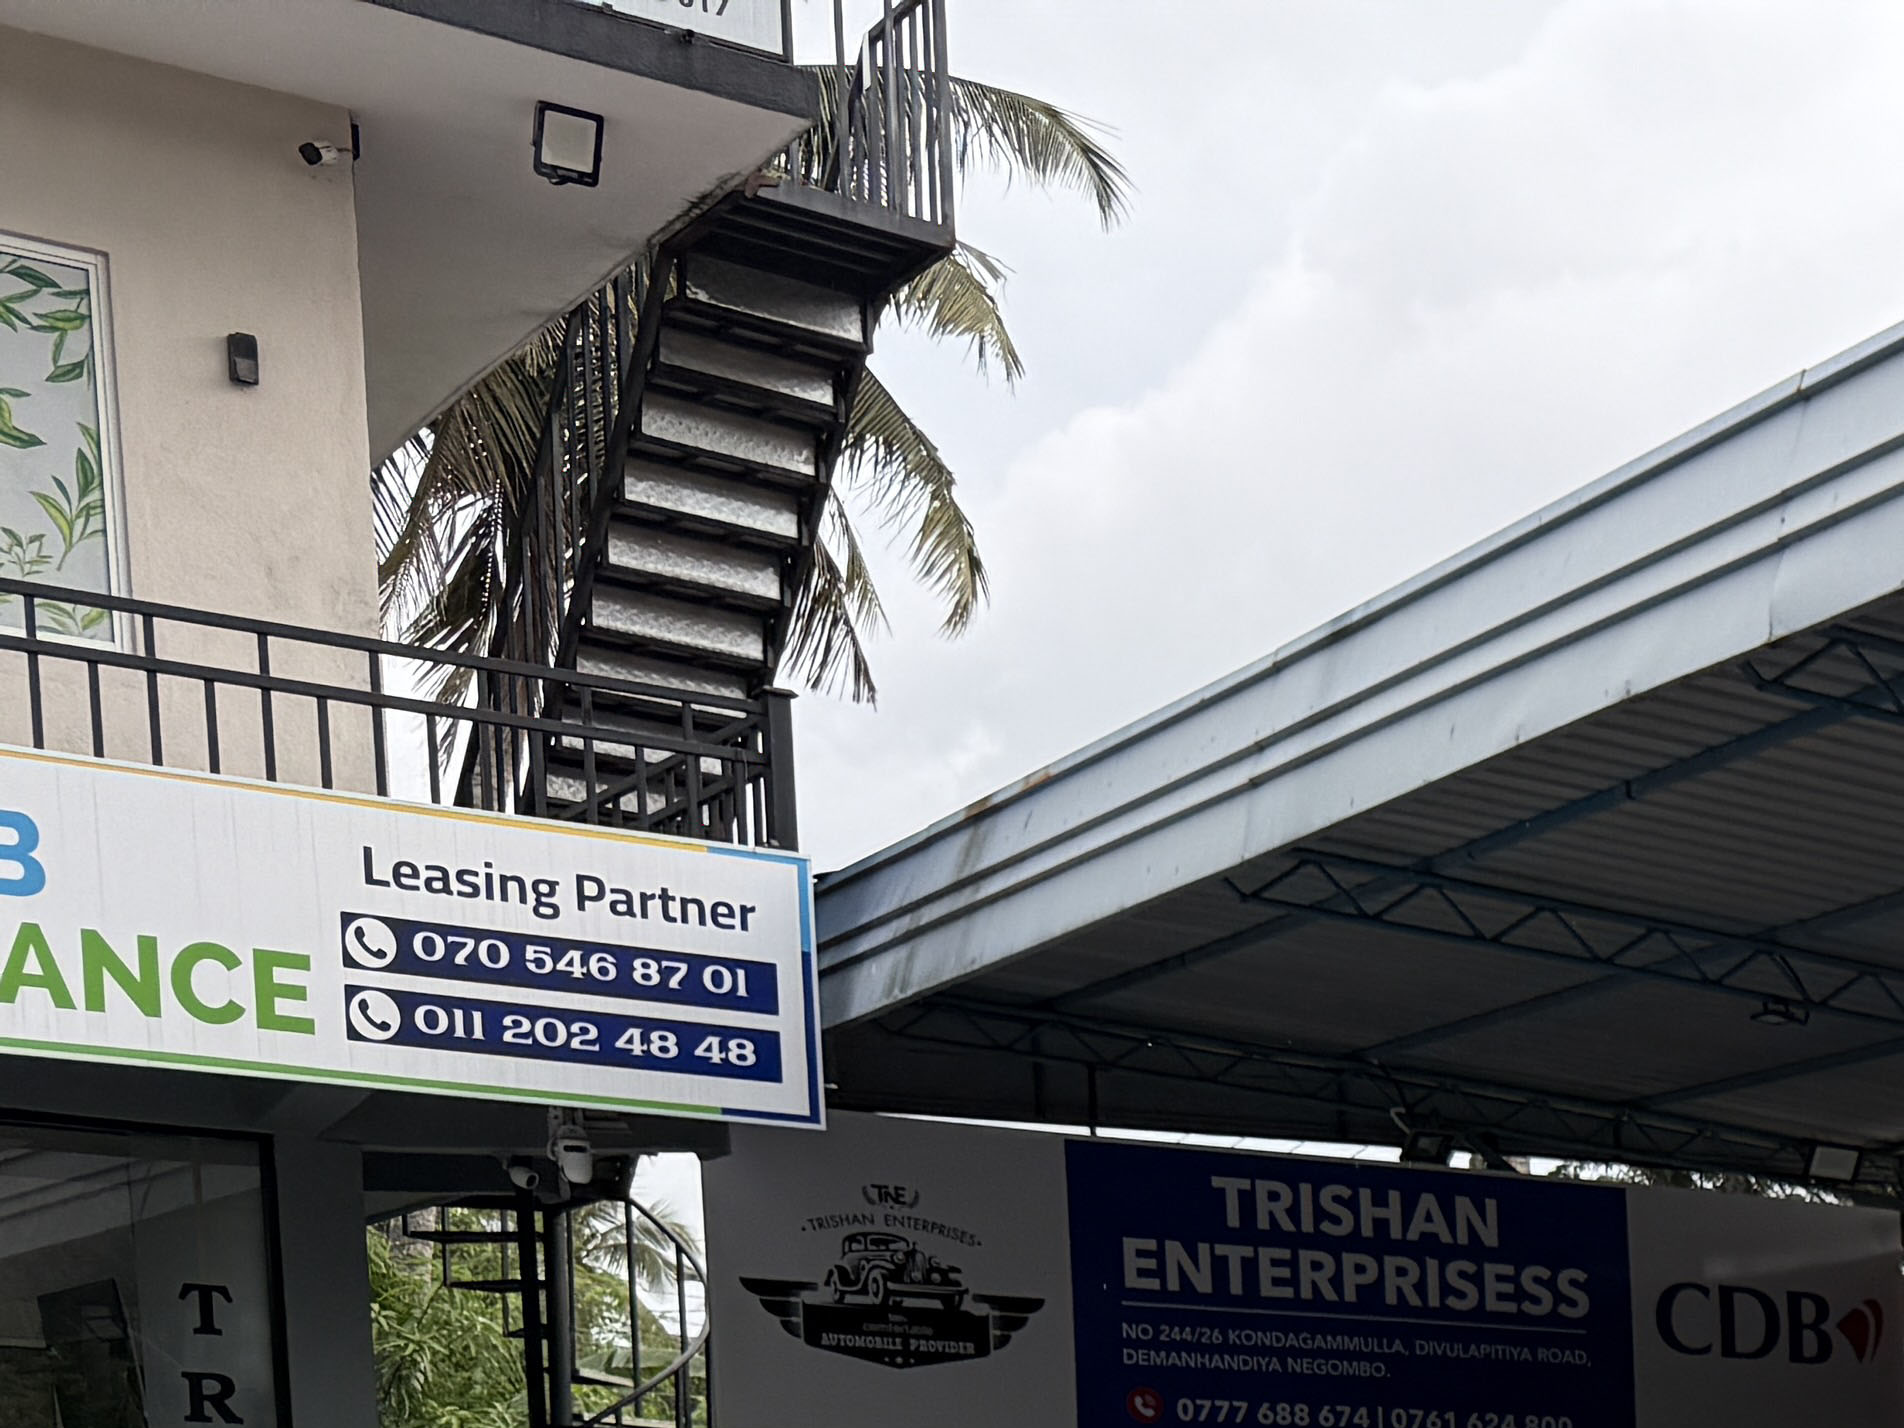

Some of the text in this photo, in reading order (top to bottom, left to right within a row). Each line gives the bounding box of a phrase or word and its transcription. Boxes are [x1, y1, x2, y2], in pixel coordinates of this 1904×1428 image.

[362, 845, 757, 932] Leasing Partner
[412, 930, 749, 998] 070 546 87 01
[413, 1004, 757, 1067] 011 202 48 48
[807, 1213, 977, 1248] TRISHAN ENTERPRISES
[1210, 1174, 1500, 1249] TRISHAN
[1121, 1235, 1591, 1320] ENTERPRISESS
[820, 1331, 976, 1355] AUTOMOBILE PROVIDER
[1121, 1321, 1592, 1369] NO 244/26 KONDAGAMMULLA, DIVULAPITIYA ROAD,
[1655, 1281, 1833, 1365] CDB
[1122, 1347, 1392, 1379] DEMANHANDIYA NEGOMBO.
[1176, 1397, 1248, 1425] 0777
[1256, 1400, 1311, 1428] 688
